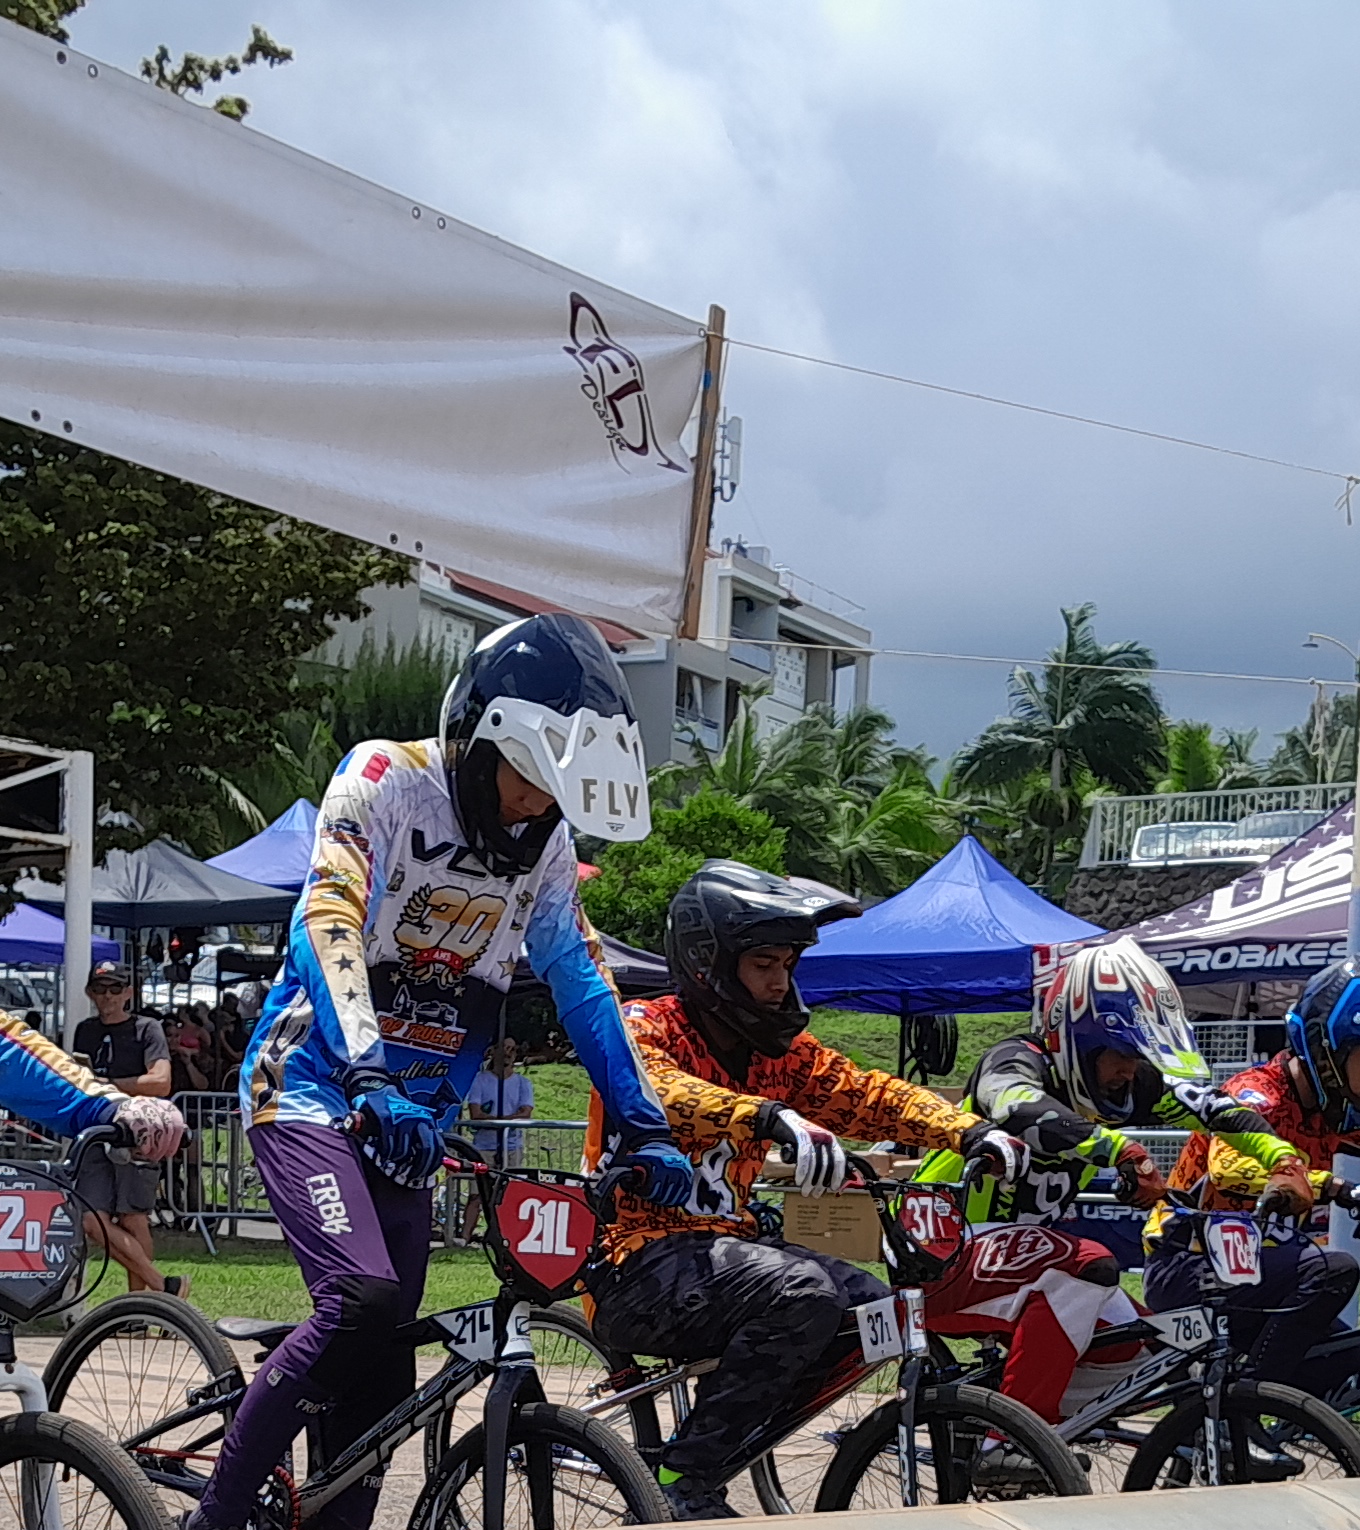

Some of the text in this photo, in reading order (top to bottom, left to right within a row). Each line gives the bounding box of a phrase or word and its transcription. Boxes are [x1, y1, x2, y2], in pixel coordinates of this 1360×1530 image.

[581, 778, 639, 819] FLY
[394, 885, 508, 959] 30
[406, 1021, 466, 1049] TRUCKS
[517, 1198, 576, 1256] 21L
[454, 1309, 490, 1346] 21L
[1172, 1315, 1202, 1343] 78G
[898, 1424, 917, 1505] BOX
